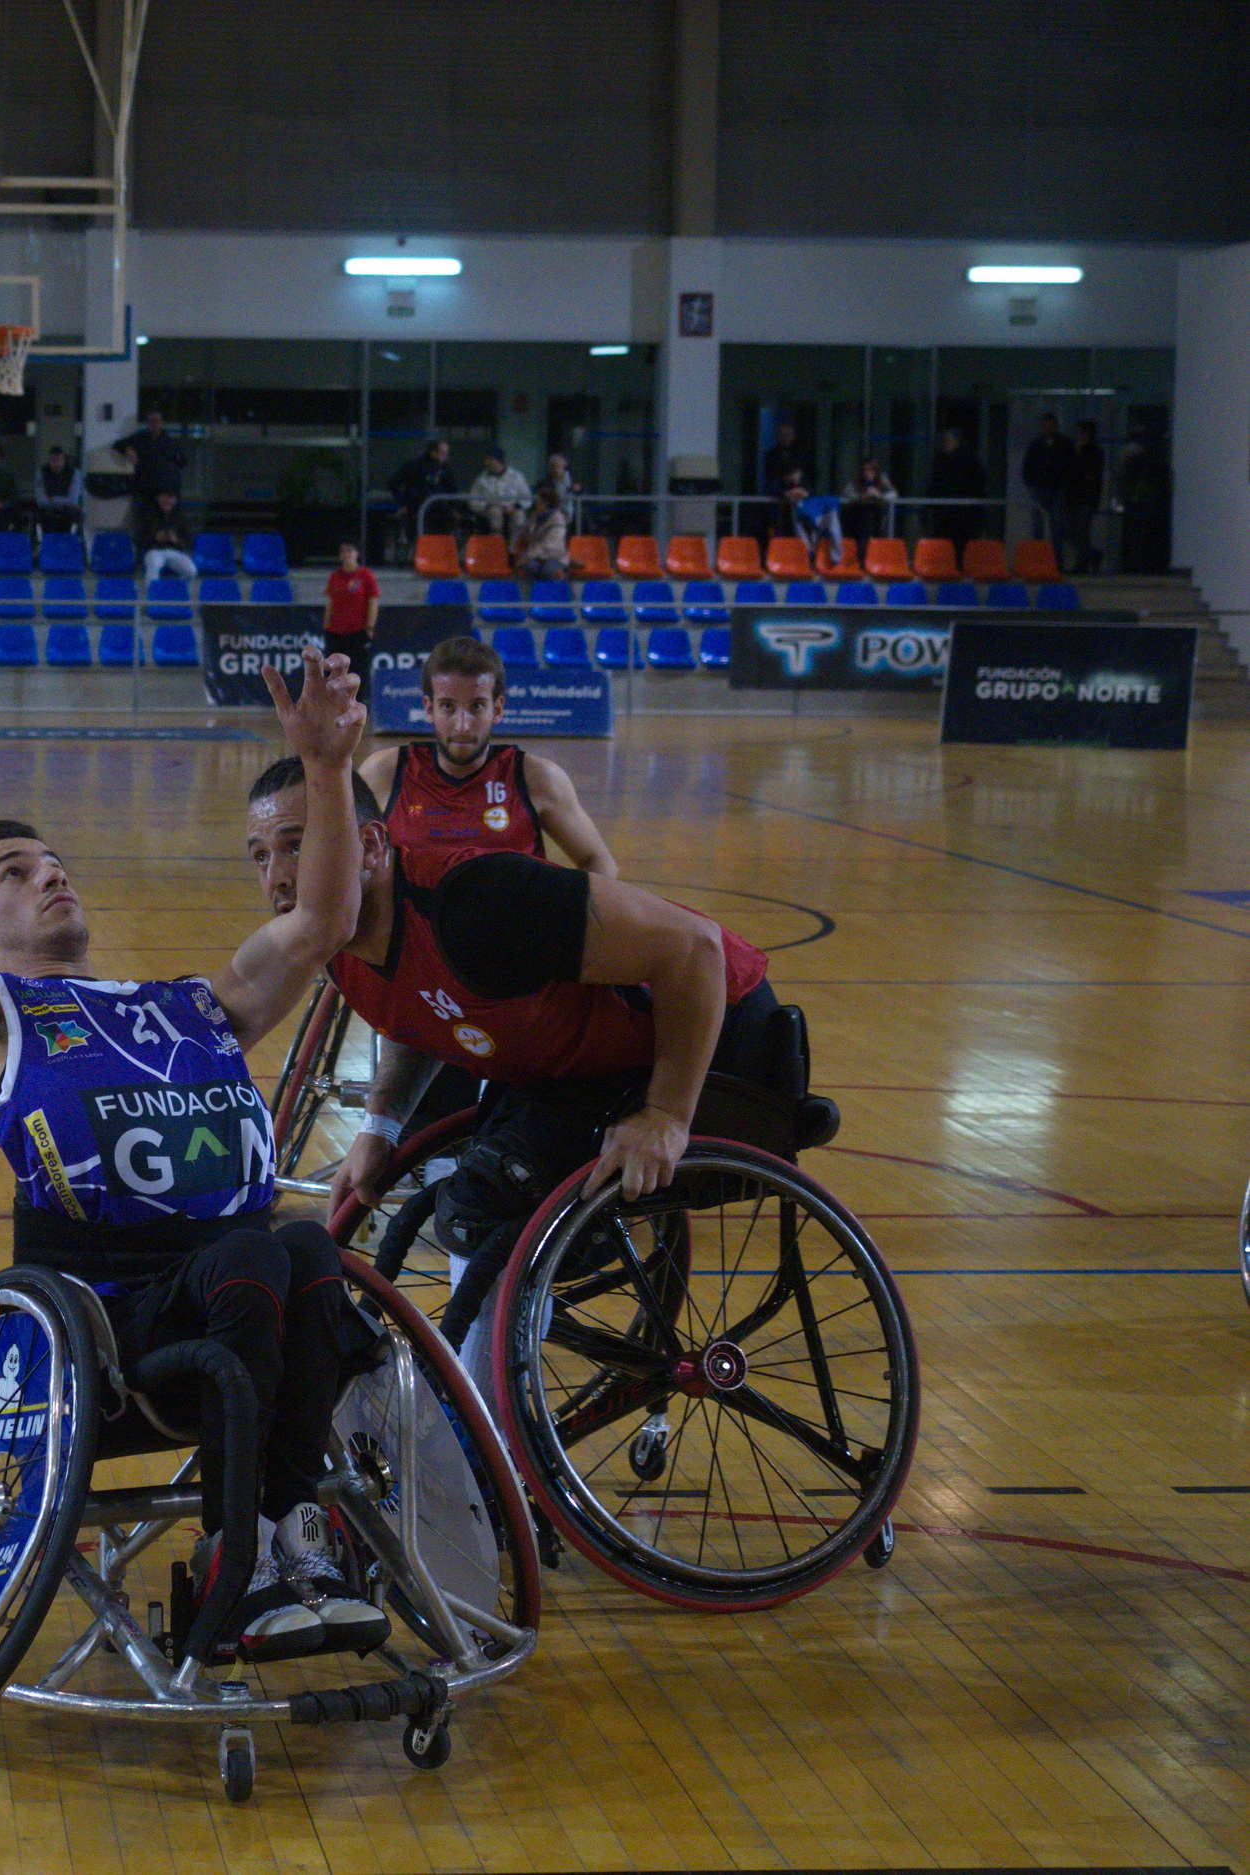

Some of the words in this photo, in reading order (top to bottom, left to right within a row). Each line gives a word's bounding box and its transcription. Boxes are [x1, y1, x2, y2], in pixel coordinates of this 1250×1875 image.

[219, 631, 326, 650] FUNDACIÓN
[219, 652, 306, 676] GRUP
[372, 652, 432, 669] ORT
[976, 665, 1063, 681] FUNDACIÓN
[528, 685, 602, 699] Valladolid
[975, 680, 1060, 702] GRUPO
[1076, 683, 1163, 704] NORTE
[484, 780, 507, 804] 16
[418, 988, 465, 1020] 59
[114, 1000, 183, 1044] 21
